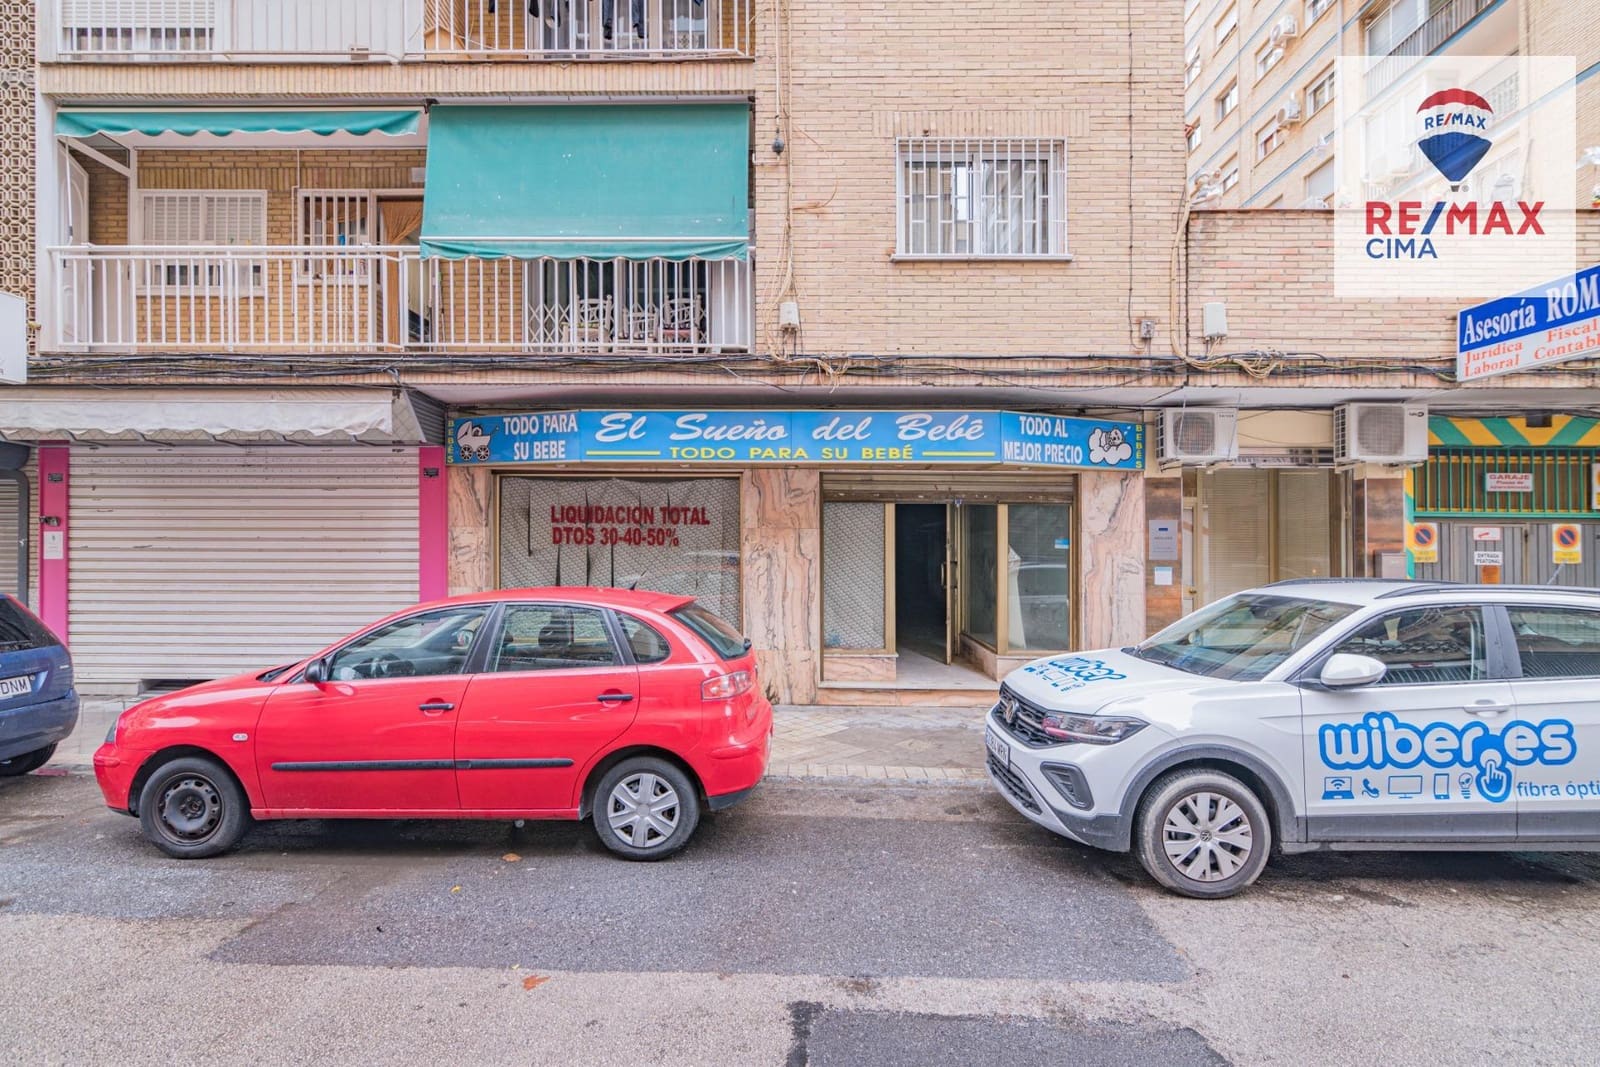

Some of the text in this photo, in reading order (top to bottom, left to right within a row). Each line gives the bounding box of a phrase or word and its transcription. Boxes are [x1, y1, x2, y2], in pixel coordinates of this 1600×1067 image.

[1462, 298, 1536, 346] Asesoría
[1547, 318, 1598, 342] Fiscal
[1464, 354, 1520, 377] Laboral
[503, 413, 578, 435] TODO PARA
[595, 412, 647, 442] El
[669, 413, 788, 441] Sueño
[812, 416, 872, 441] del
[1019, 415, 1068, 437] TODO AL
[514, 440, 566, 460] SU BEBE
[669, 444, 913, 459] TODO PARA SU BEBÉ
[1003, 441, 1083, 464] MEJOR PRECIO
[660, 506, 710, 525] TOTAL
[552, 527, 679, 547] DTOS 30-40-50%
[1321, 713, 1575, 768] wiber.es
[1516, 780, 1600, 799] fibra ópti
